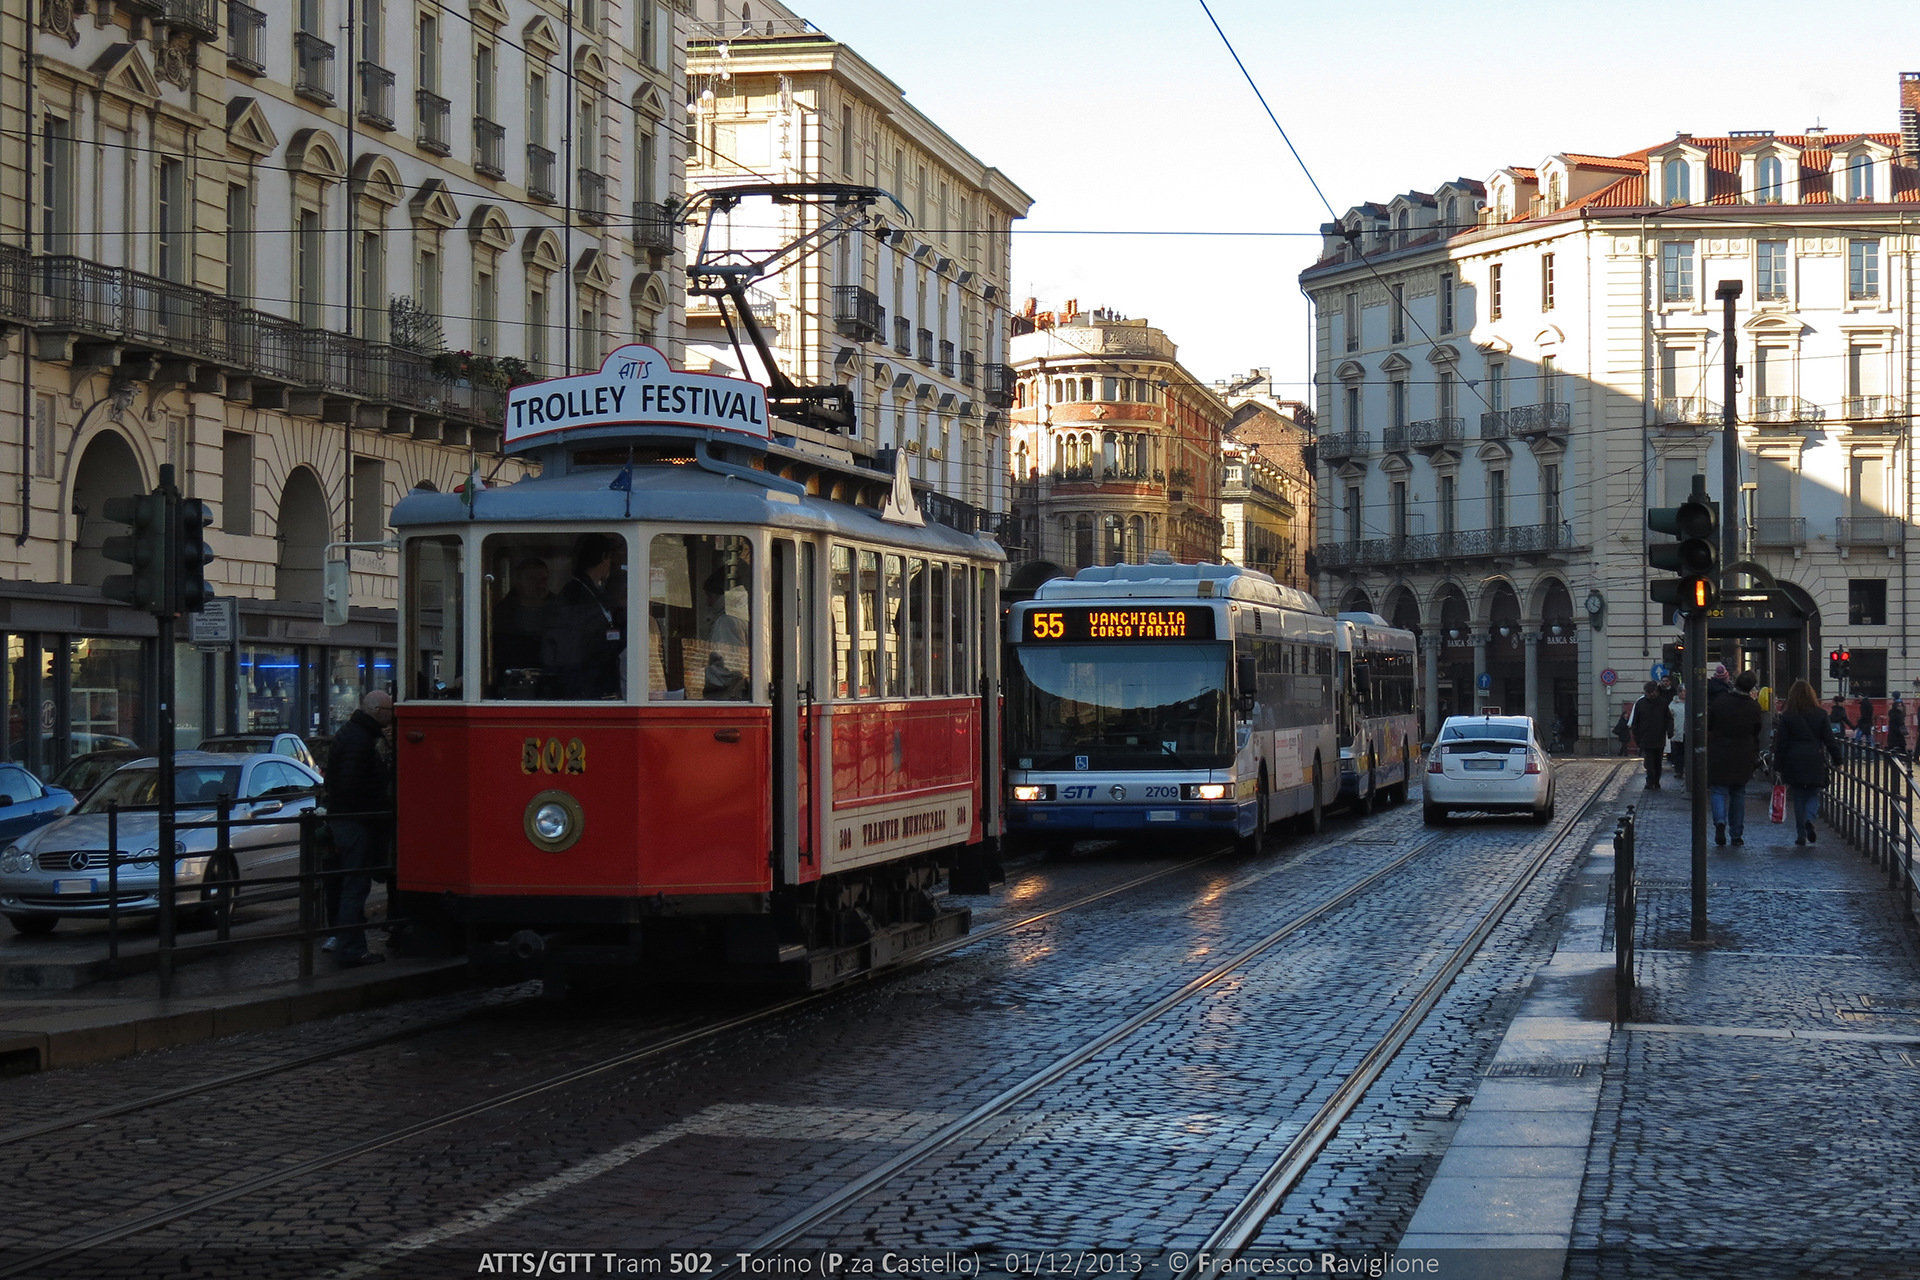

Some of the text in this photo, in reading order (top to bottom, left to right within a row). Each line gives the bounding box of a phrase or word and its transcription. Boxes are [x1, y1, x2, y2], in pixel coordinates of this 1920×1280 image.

[618, 361, 653, 380] ATTS
[511, 385, 762, 428] TROLLEY FESTIVAL
[1033, 611, 1186, 638] 55 VANCHIGLIA
[1090, 625, 1186, 637] CORSO FARINI
[521, 737, 586, 775] 502
[1145, 787, 1178, 797] 2709
[902, 809, 946, 839] MUNICIPALI
